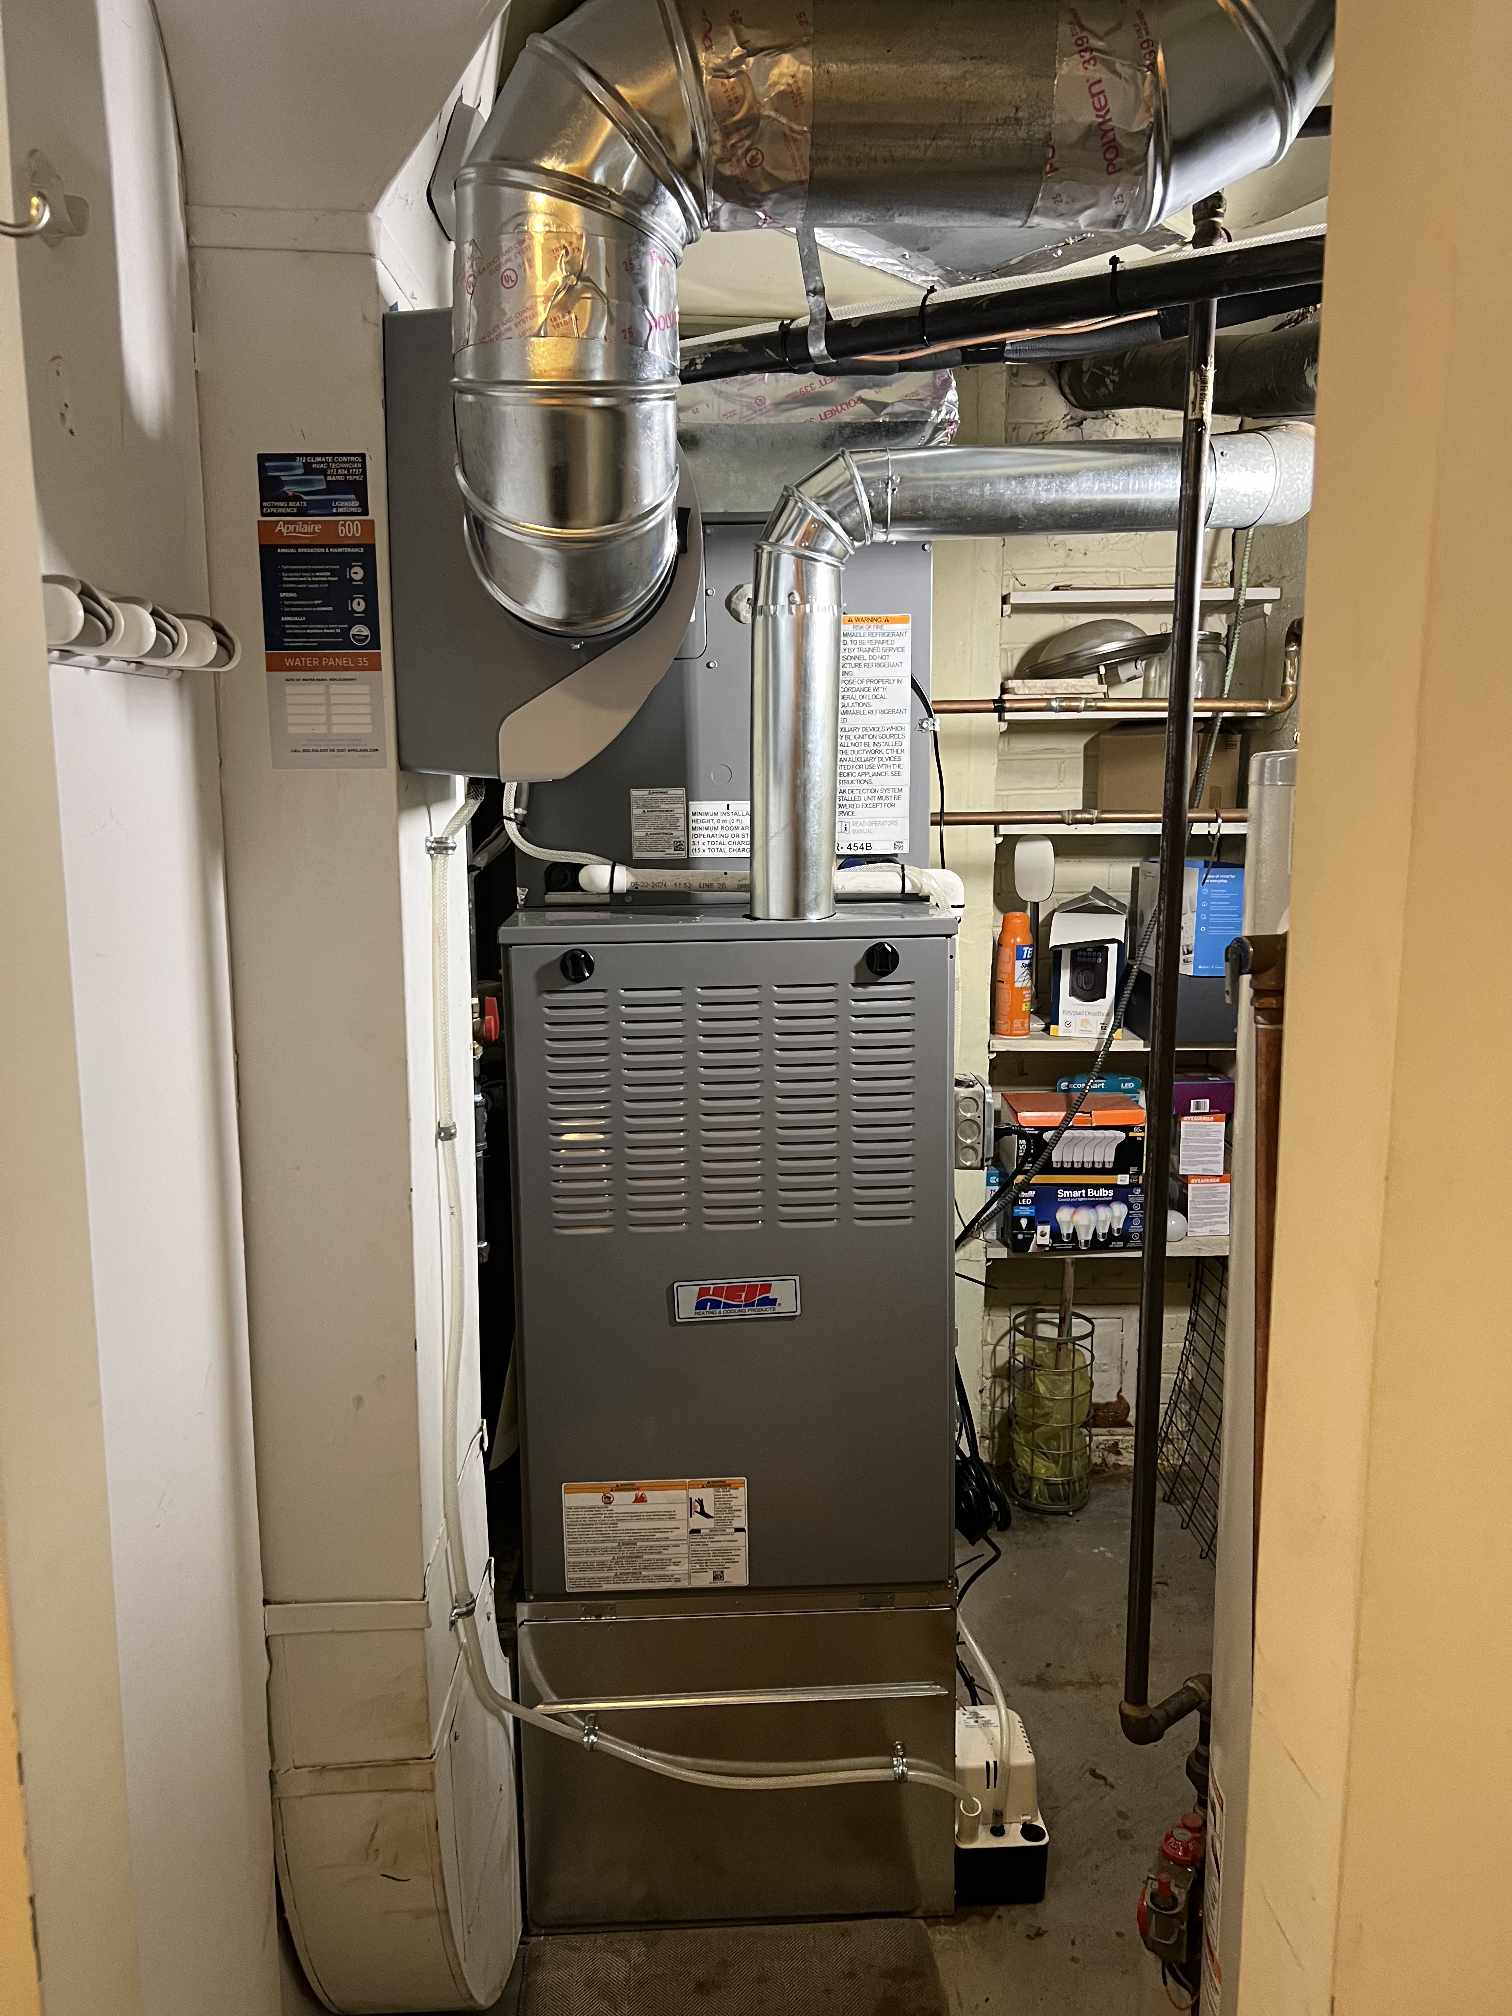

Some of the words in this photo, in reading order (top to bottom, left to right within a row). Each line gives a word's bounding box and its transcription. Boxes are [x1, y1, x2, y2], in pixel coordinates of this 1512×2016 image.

[1074, 35, 1097, 70] 339
[1088, 79, 1122, 176] POLYKEN
[818, 397, 863, 421] POLYKEN
[276, 521, 322, 534] Aprilaire
[338, 520, 361, 537] 600
[285, 658, 319, 667] WATER
[322, 658, 354, 667] PANEL
[358, 658, 369, 667] 35
[1058, 1189, 1086, 1198] Smart
[1088, 1188, 1114, 1197] Bulbs
